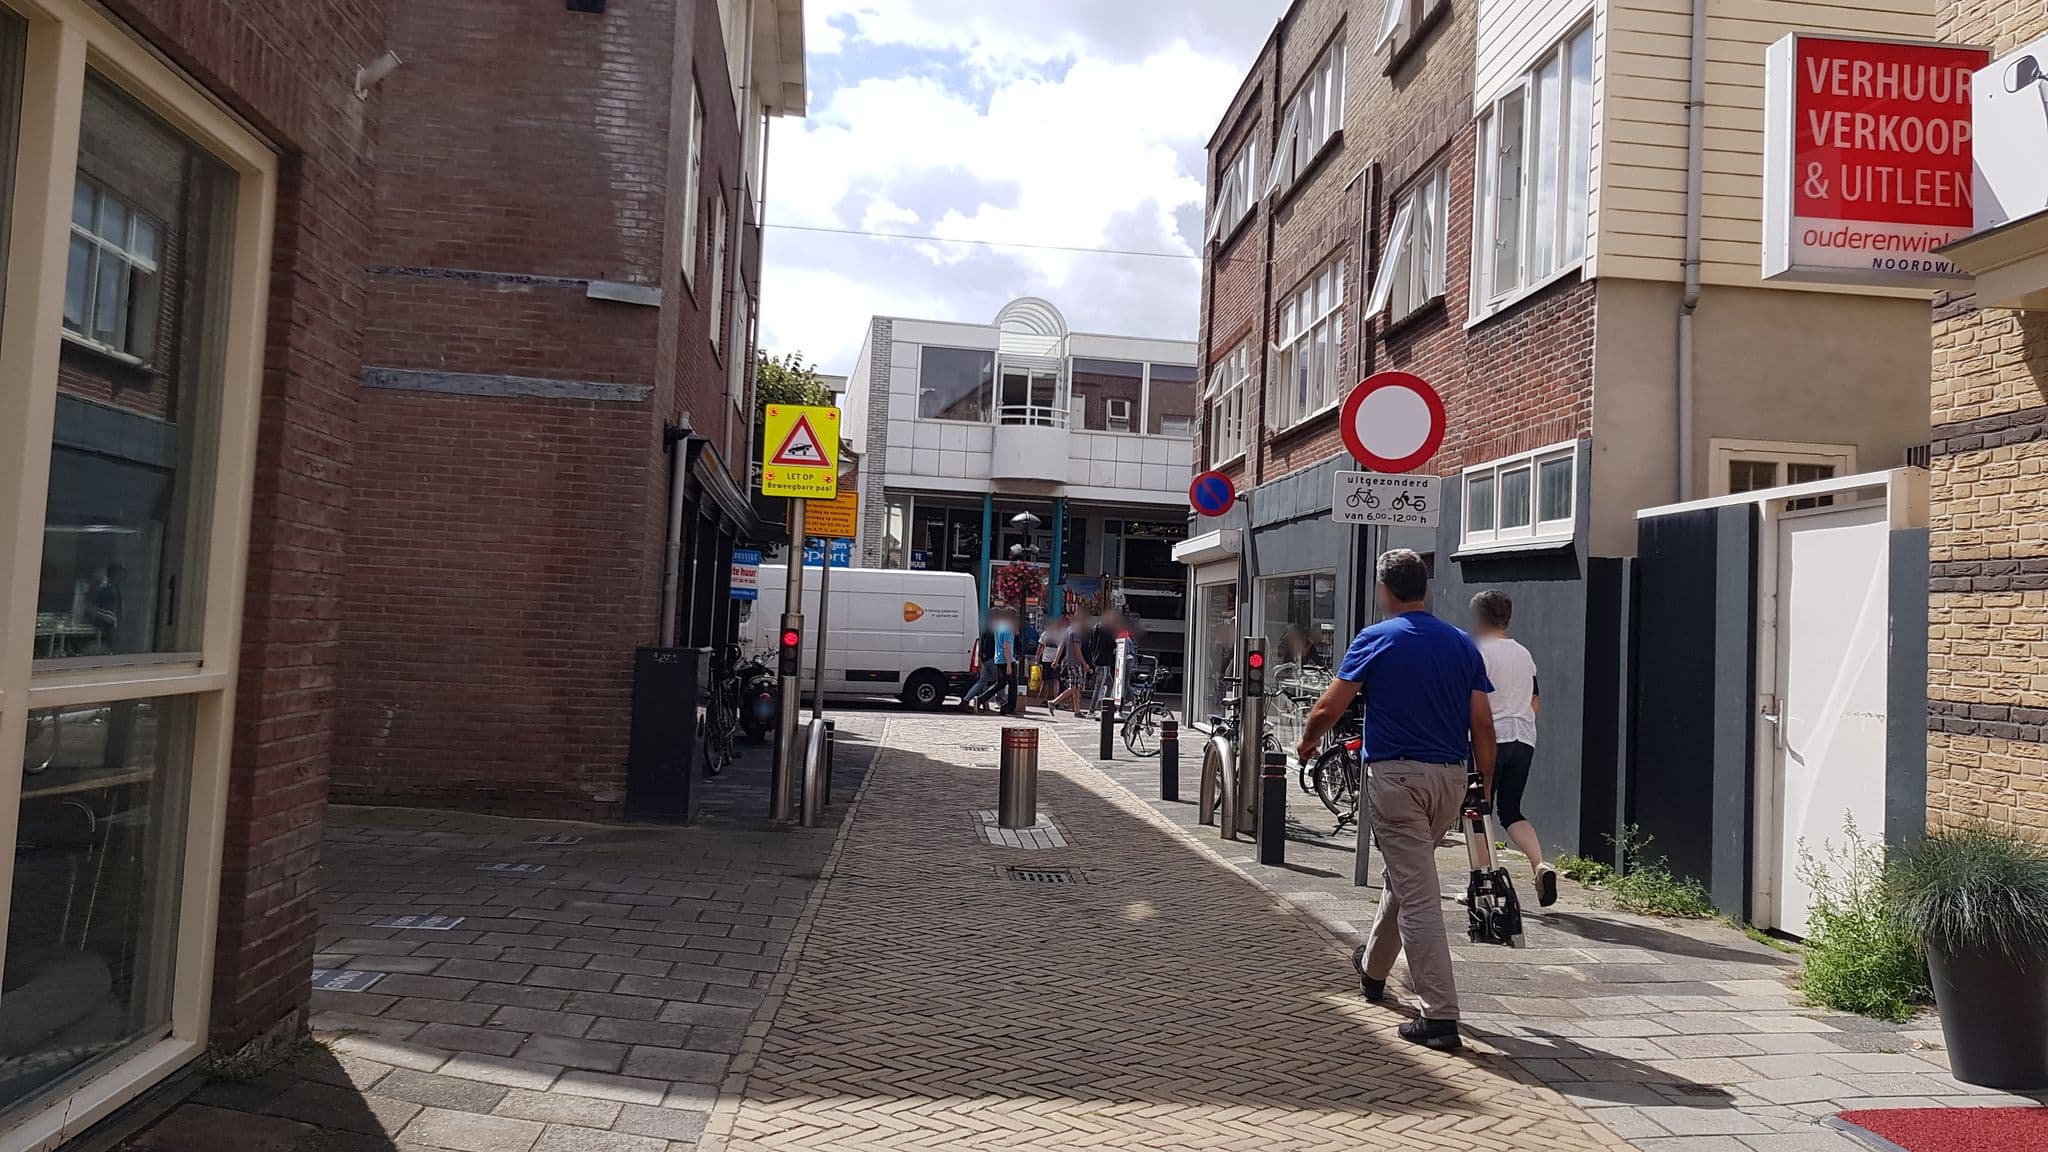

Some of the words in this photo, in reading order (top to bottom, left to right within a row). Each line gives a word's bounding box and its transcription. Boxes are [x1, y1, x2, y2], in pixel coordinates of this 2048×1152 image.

[1806, 56, 1973, 105] VERHUUR
[1808, 109, 1973, 156] VERKOOP
[1804, 161, 1829, 199] &
[1841, 164, 1973, 208] UITLEEN
[1803, 225, 1957, 253] ouderenwin
[1872, 257, 1968, 274] NOORDWI
[787, 472, 800, 480] LET
[802, 473, 814, 481] OP
[1347, 476, 1428, 488] uitgezonderd
[767, 482, 814, 491] Beweegbare
[1420, 516, 1427, 524] h
[740, 568, 757, 577] huur
